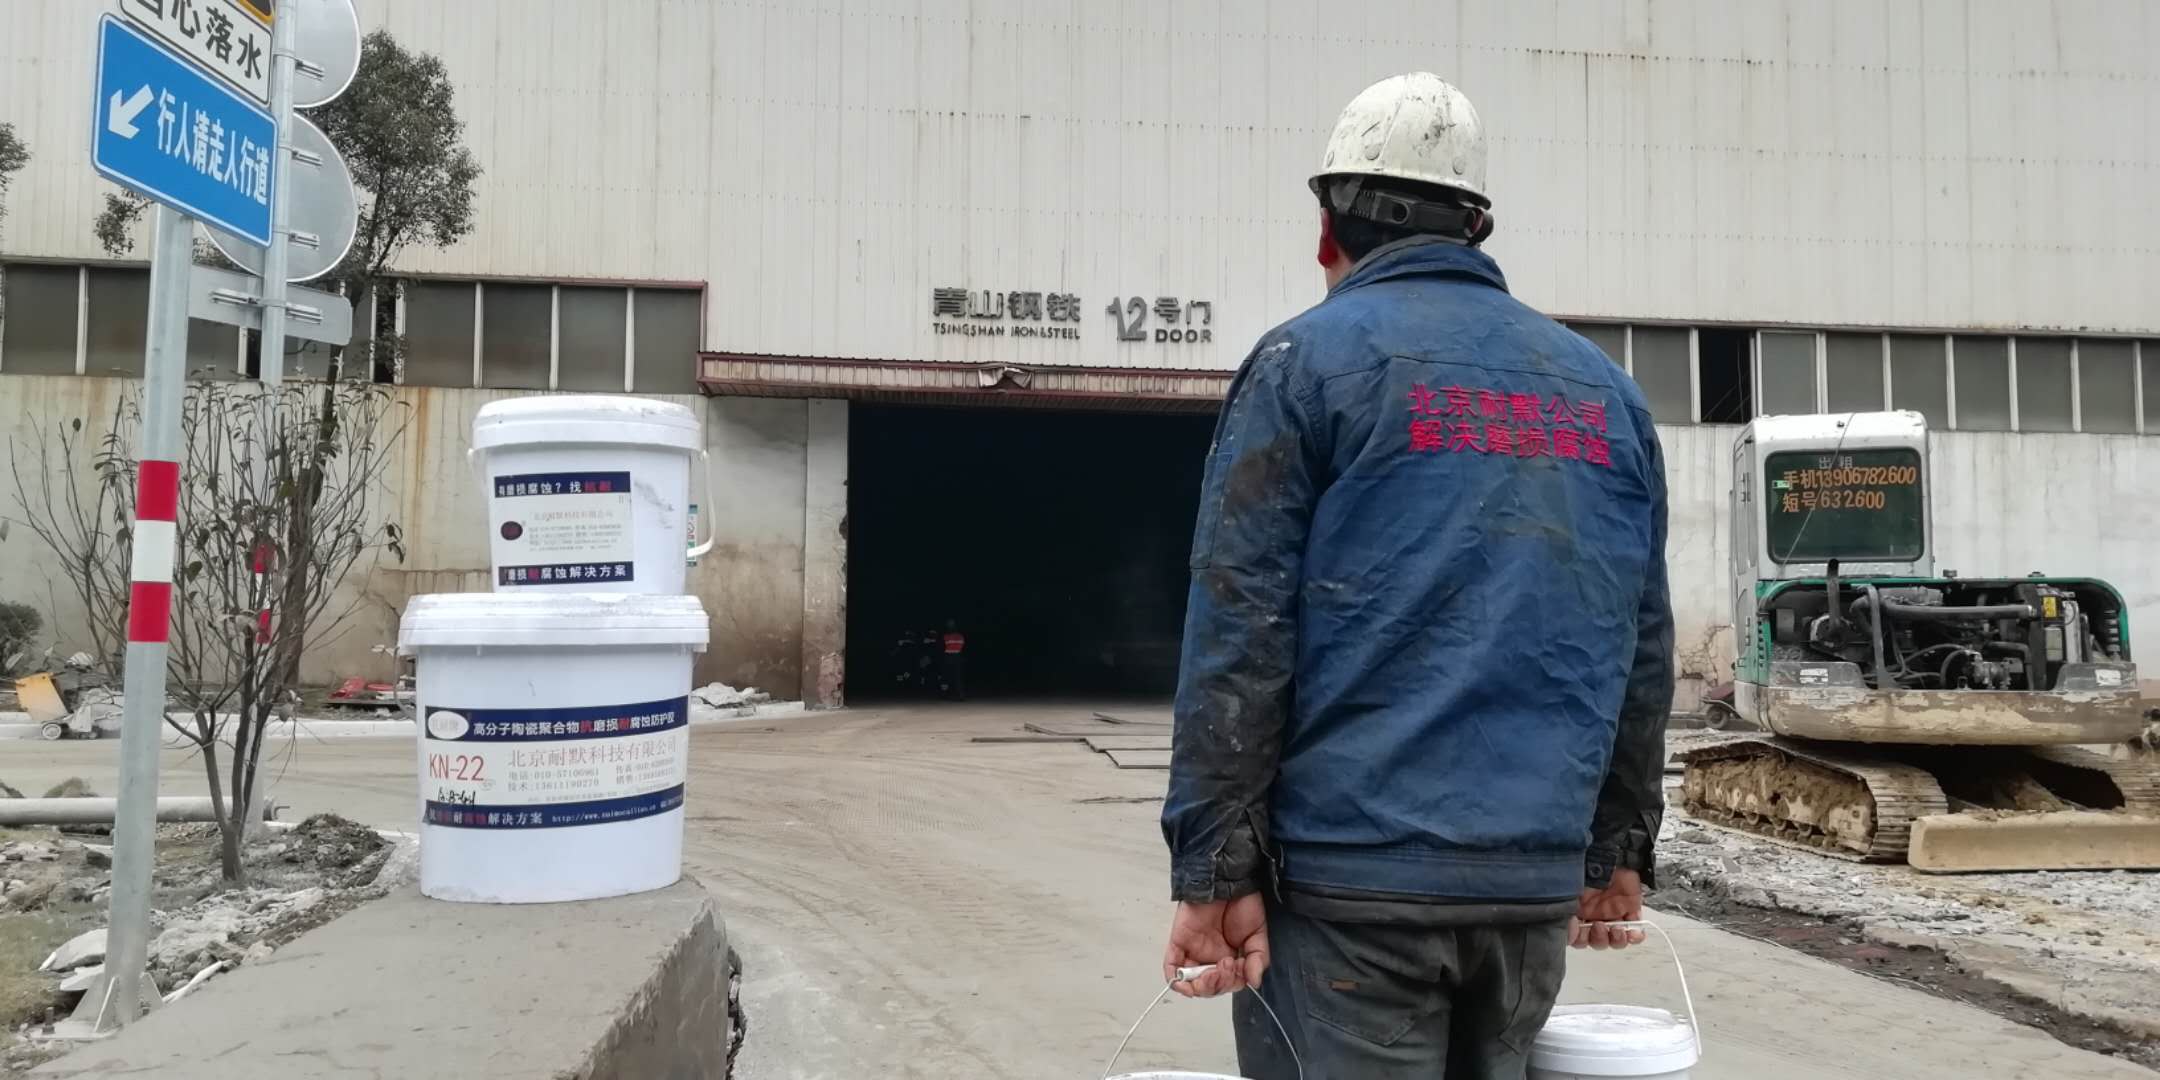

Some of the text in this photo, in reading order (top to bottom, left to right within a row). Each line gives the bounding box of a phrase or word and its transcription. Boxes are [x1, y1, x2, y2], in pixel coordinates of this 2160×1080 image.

[157, 87, 269, 206] 行人请走人行道
[933, 287, 1081, 322] 青山钢铁
[933, 323, 1005, 337] TSINGSHAN
[1155, 328, 1212, 343] DOOR
[1407, 382, 1608, 433] 北京耐默公司
[1407, 418, 1613, 468] 解决磨损腐蚀
[429, 752, 485, 781] KN-22
